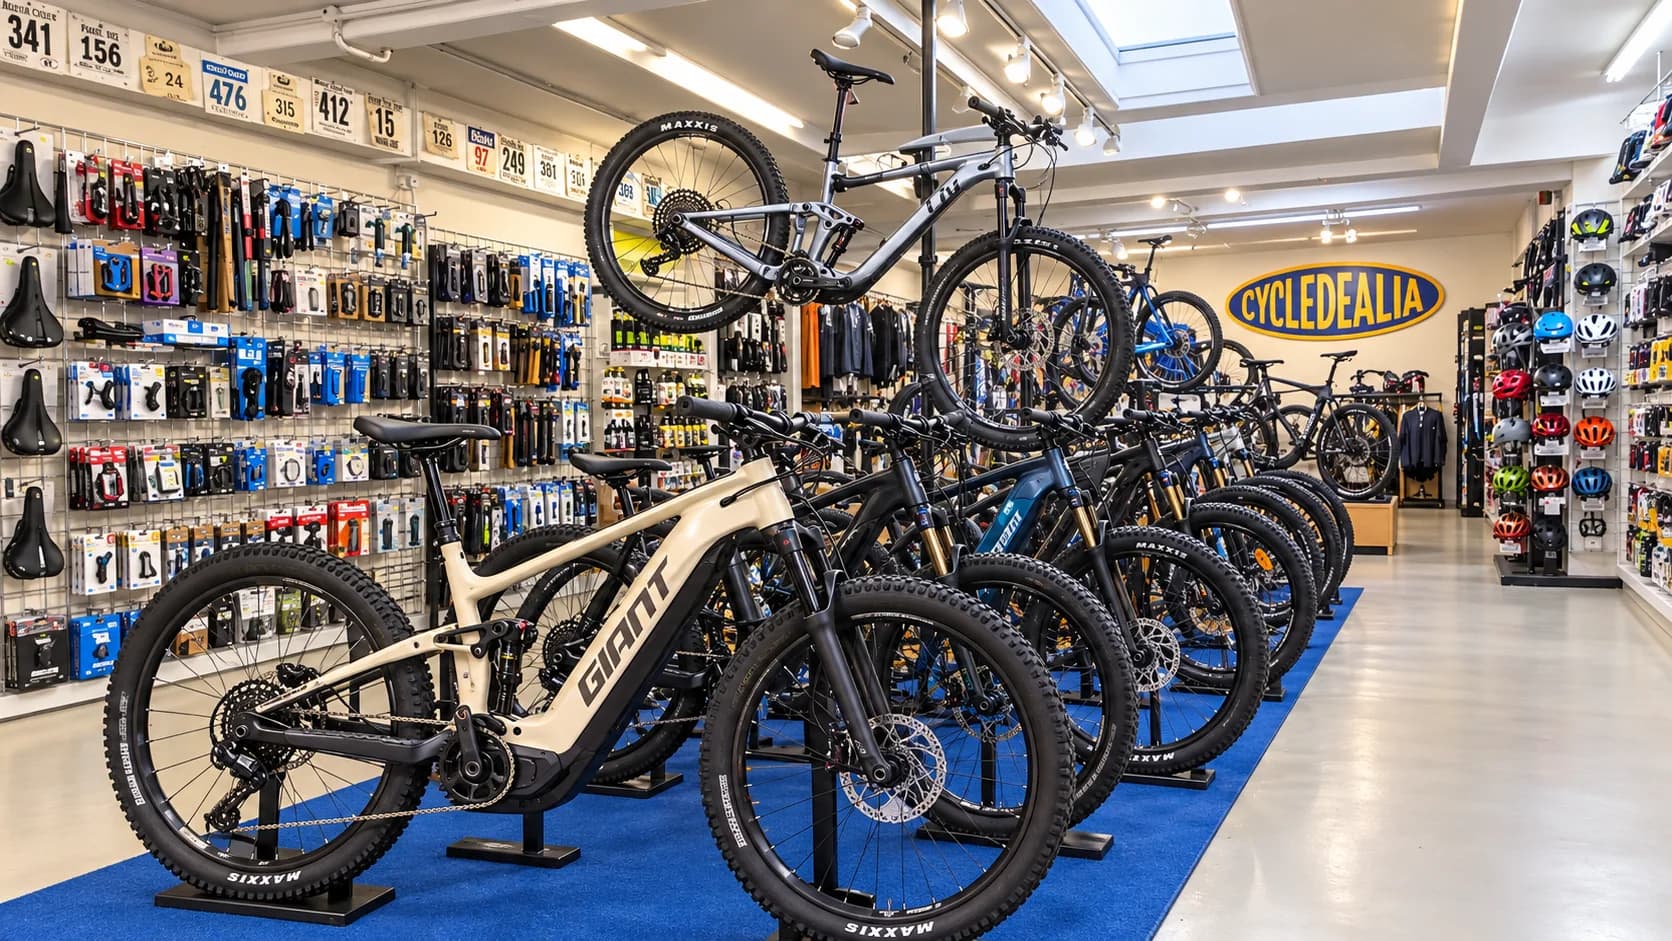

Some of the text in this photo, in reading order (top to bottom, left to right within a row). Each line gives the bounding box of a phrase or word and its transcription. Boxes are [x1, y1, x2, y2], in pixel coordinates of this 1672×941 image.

[8, 14, 51, 56] 341
[81, 36, 122, 67] 156
[165, 72, 184, 88] 24
[209, 79, 247, 111] 476
[275, 98, 295, 118] 315
[319, 92, 349, 126] 412
[375, 107, 395, 137] 15
[660, 120, 718, 132] MAXXIS
[432, 129, 452, 147] 126
[474, 146, 489, 167] 97
[502, 147, 525, 175] 249
[1241, 272, 1424, 330] CYCLEDEALIA
[577, 554, 670, 708] GIANT
[226, 870, 301, 885] MAXXIS
[844, 921, 934, 938] MAXXIS
